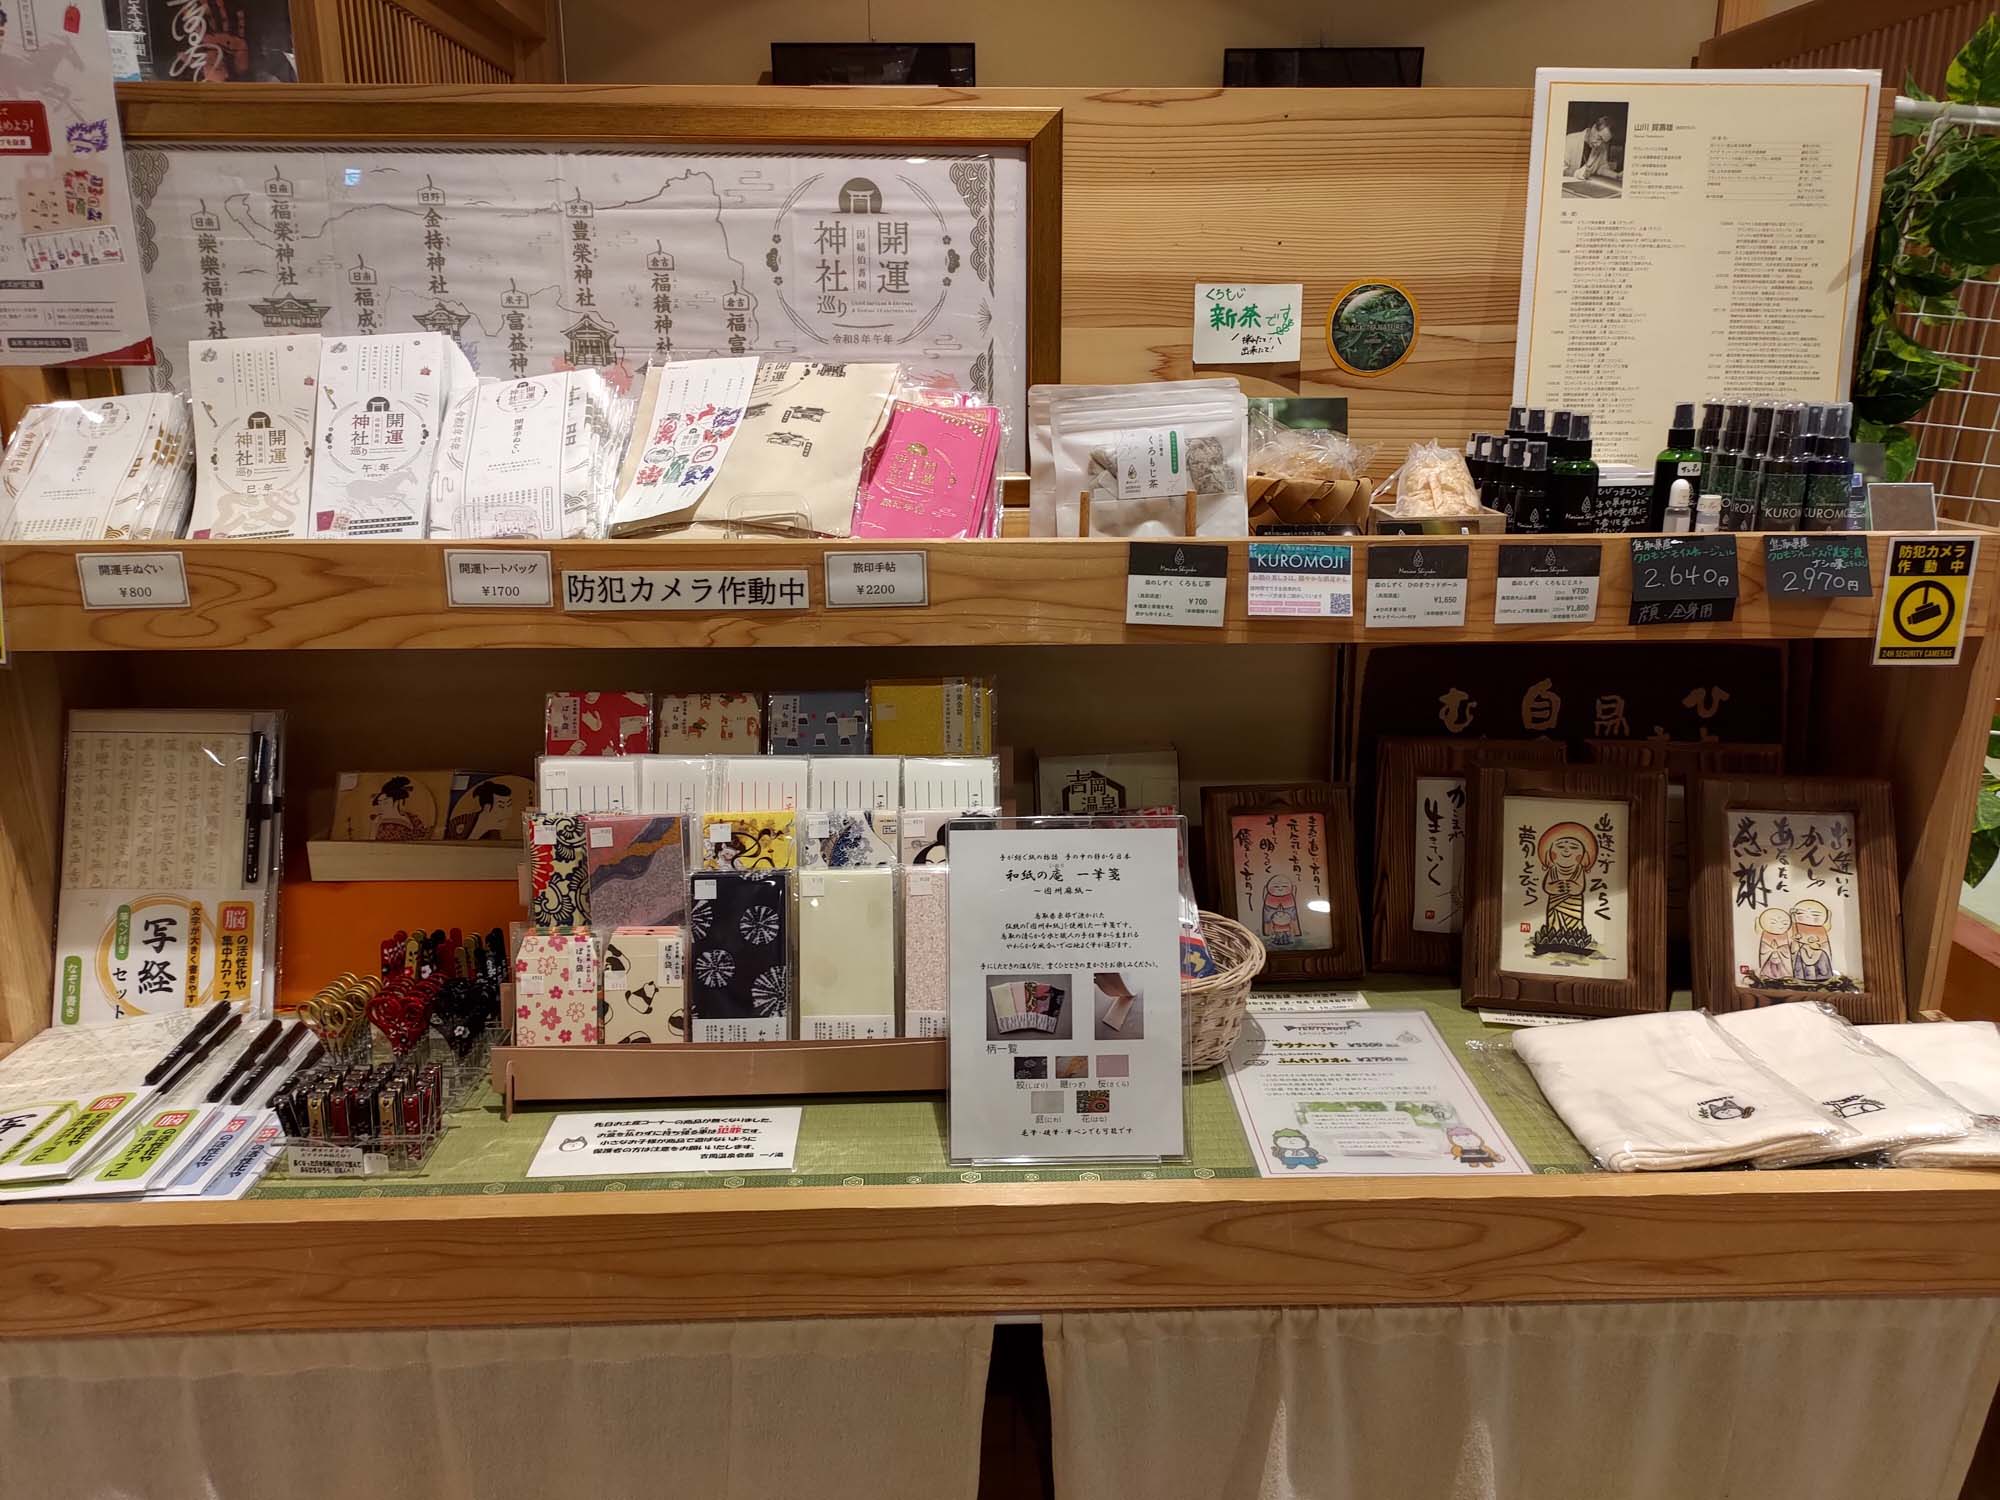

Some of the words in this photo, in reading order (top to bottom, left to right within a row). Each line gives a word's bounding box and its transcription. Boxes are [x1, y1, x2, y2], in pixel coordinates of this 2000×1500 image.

[423, 208, 449, 294] 金持神社
[877, 221, 910, 294] 開運
[507, 311, 529, 379] 富益神
[386, 413, 404, 445] 開運
[268, 430, 287, 465] 開運
[1257, 553, 1344, 569] KUROMOJI
[1899, 545, 1967, 559] 防犯カメラ
[98, 564, 164, 576] 開運手ぬぐい
[458, 562, 538, 575] 開運トートバッグ
[853, 562, 897, 573] 旅印手帖
[119, 586, 152, 598] ¥800
[481, 586, 520, 597] ¥1700
[567, 574, 805, 606] 防犯カメラ作動中
[856, 584, 896, 595] ¥2200
[1895, 650, 1924, 658] SECURITY
[1924, 650, 1953, 658] CAMERAS
[1066, 769, 1107, 796] 吉岡
[1081, 794, 1117, 812] 温泉
[1733, 815, 1772, 910] 感謝
[1077, 868, 1121, 882] 一筆箋
[224, 909, 248, 930] 脳
[137, 917, 178, 995] 写経
[234, 935, 249, 990] の活性化や
[112, 967, 128, 1019] セット
[985, 1042, 1018, 1055] 柄一覧
